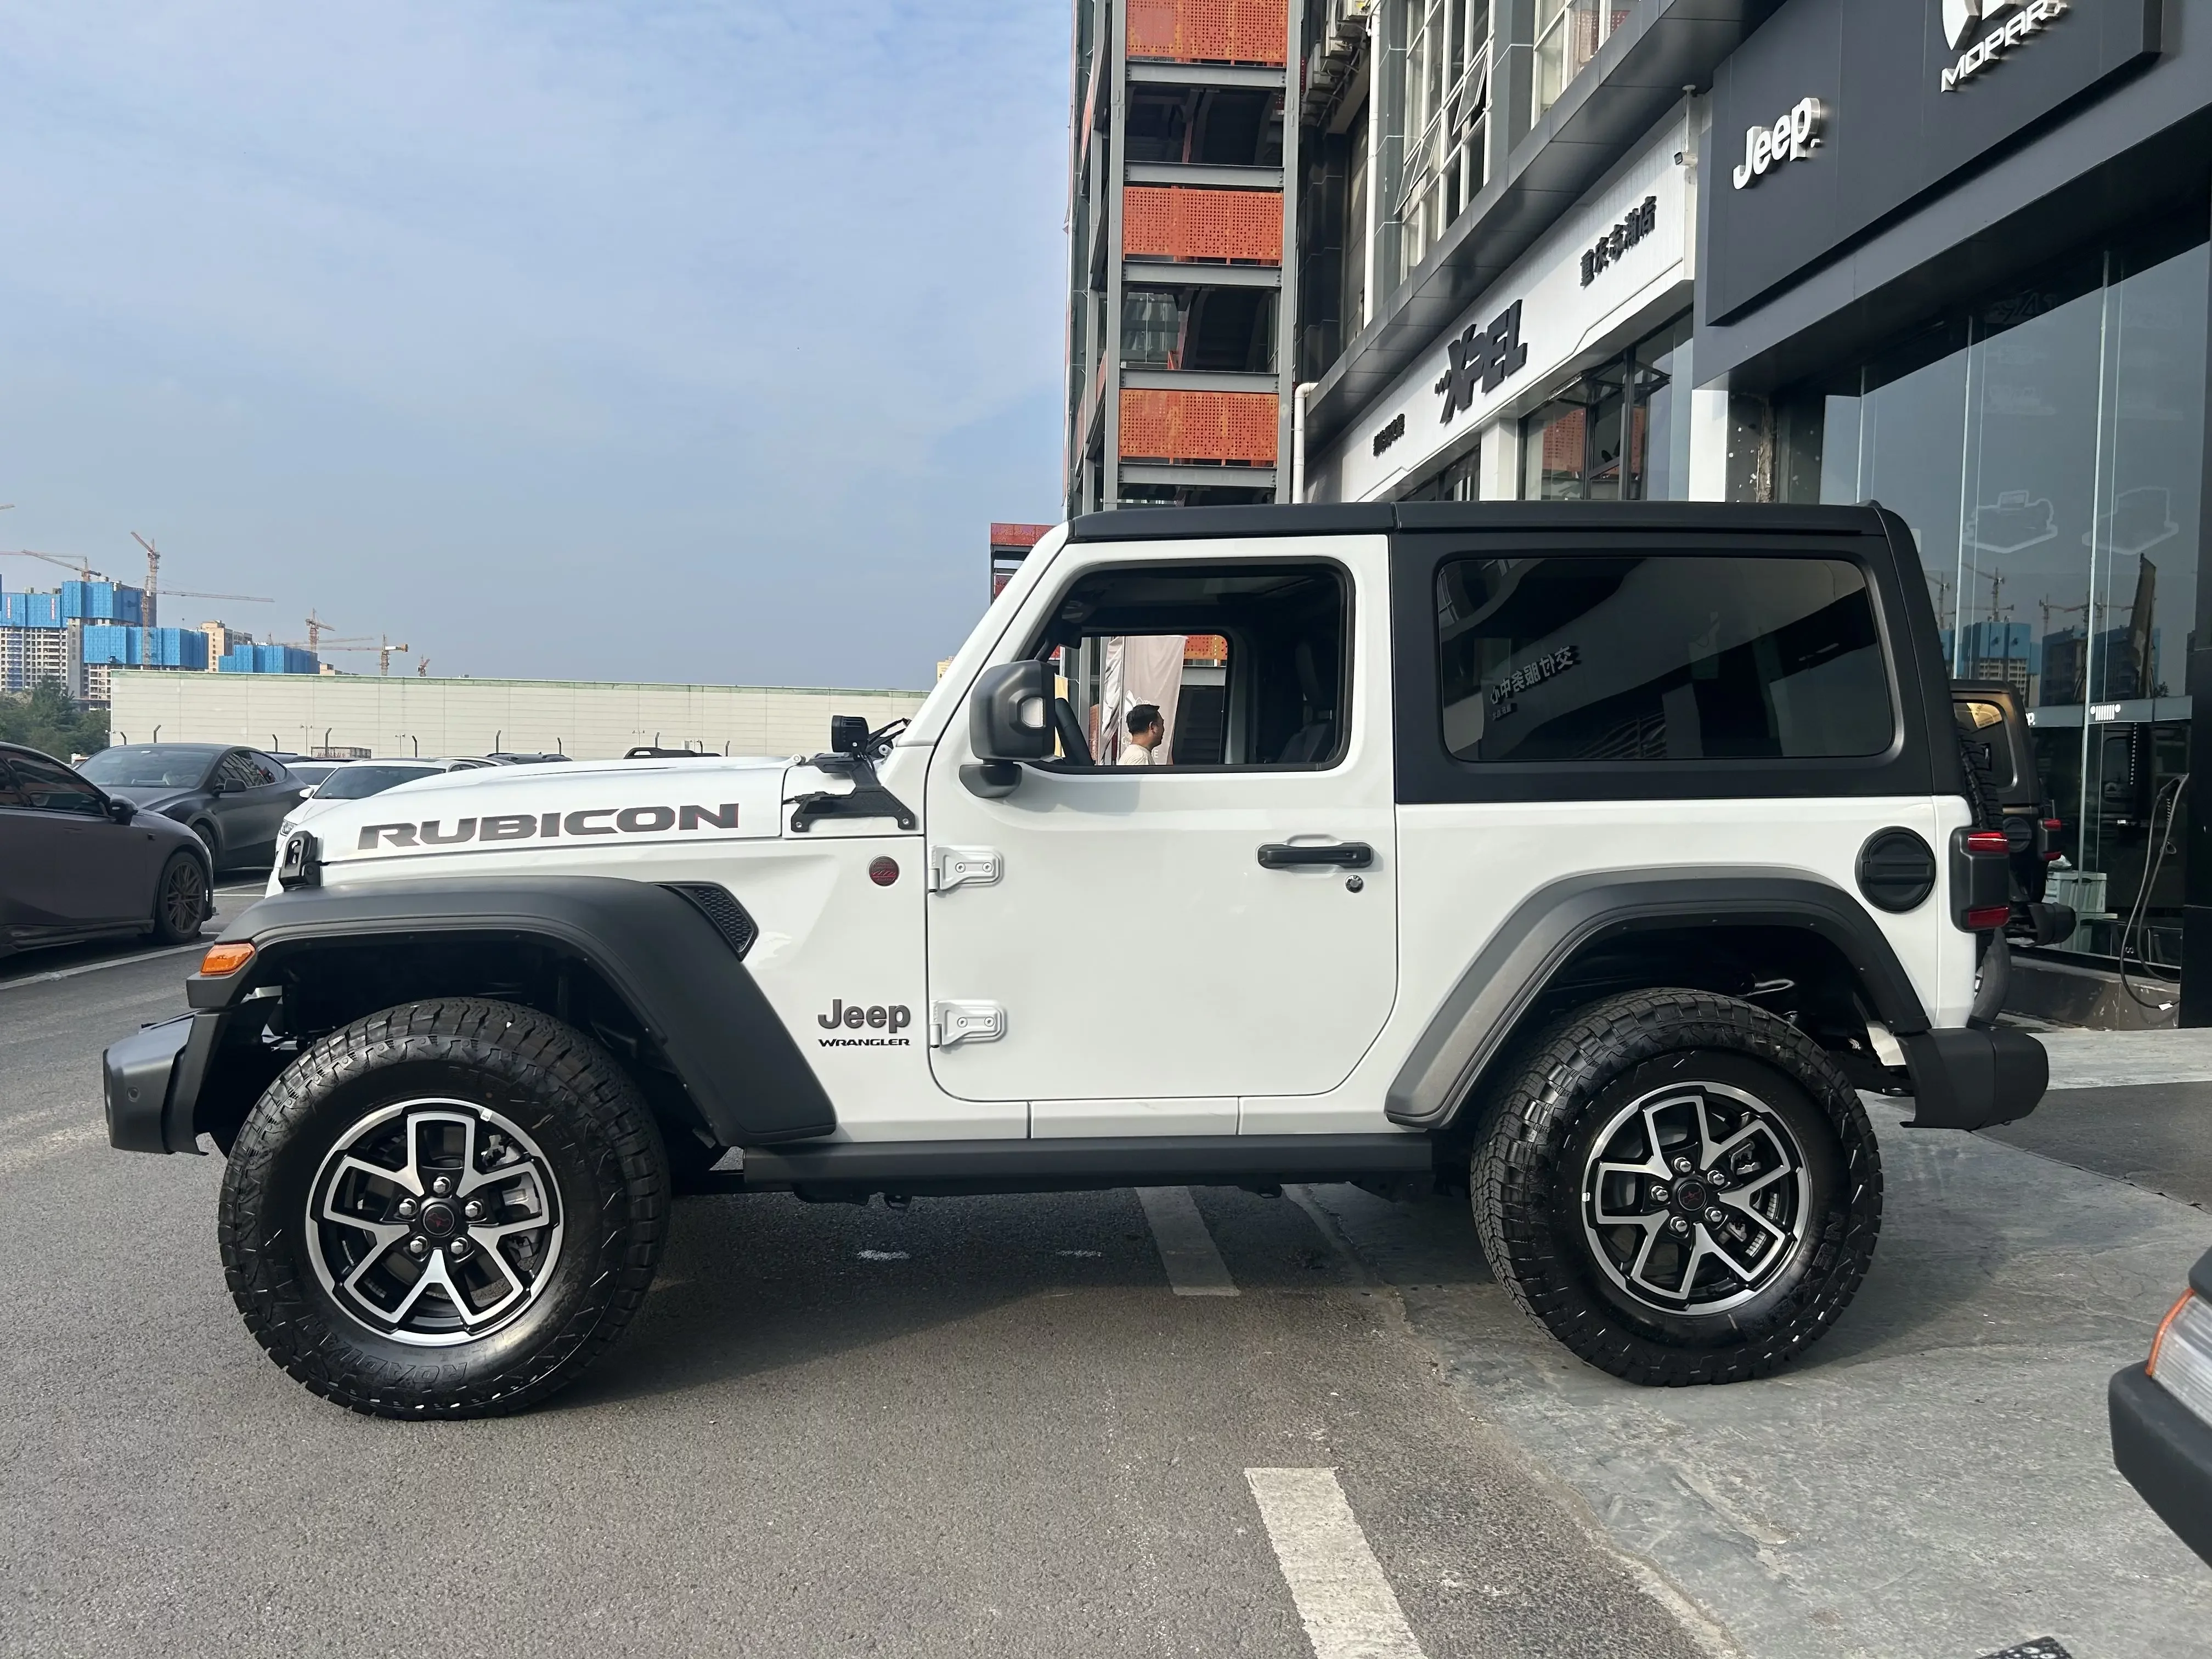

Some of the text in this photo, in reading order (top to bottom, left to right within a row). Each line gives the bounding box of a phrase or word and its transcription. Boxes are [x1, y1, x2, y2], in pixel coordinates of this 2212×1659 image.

[1940, 0, 2051, 93] MOPAR
[1733, 97, 1820, 190] Jeep
[1436, 299, 1528, 424] XPEL
[358, 803, 739, 850] RUBICON
[817, 999, 911, 1033] Jeep
[818, 1039, 911, 1047] WRANGLER
